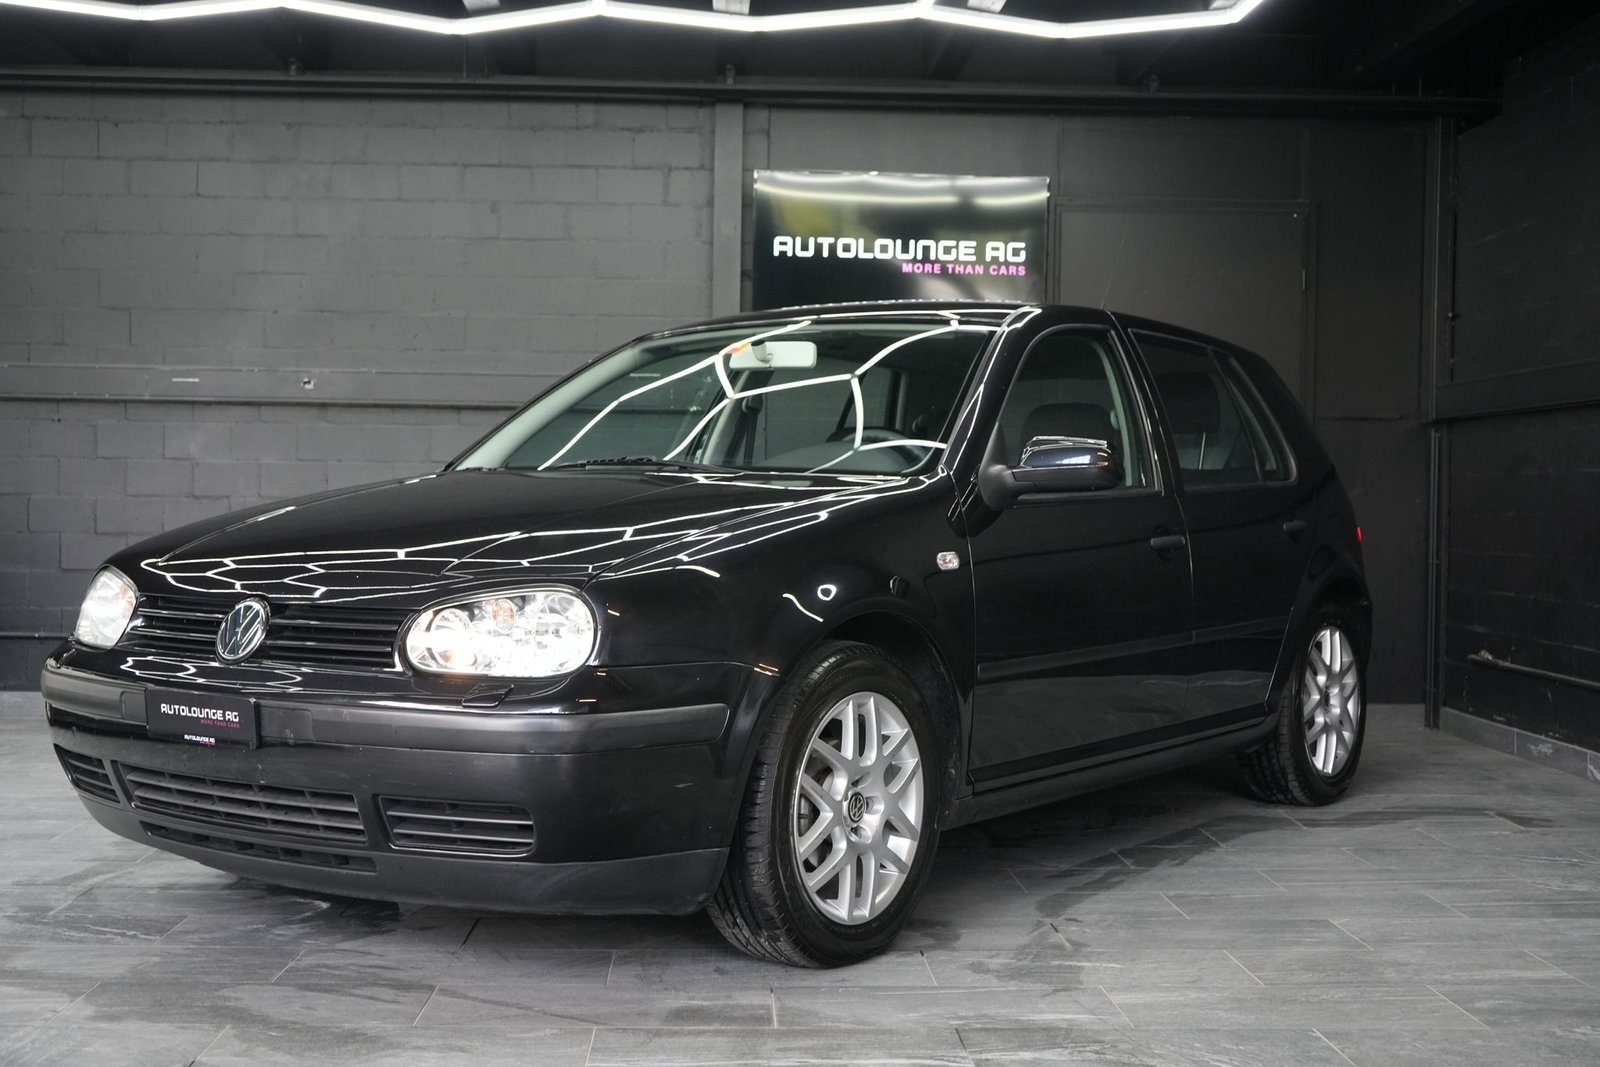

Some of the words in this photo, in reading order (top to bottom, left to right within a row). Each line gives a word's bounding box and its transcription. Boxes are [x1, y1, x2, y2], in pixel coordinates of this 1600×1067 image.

[773, 236, 977, 261] AUTOLOUNGE
[985, 241, 1026, 263] AG
[902, 263, 941, 274] MORE
[948, 264, 984, 275] THAN
[990, 265, 1026, 276] CARS
[160, 703, 224, 720] AUTOLOUNGE
[225, 711, 239, 722] AG
